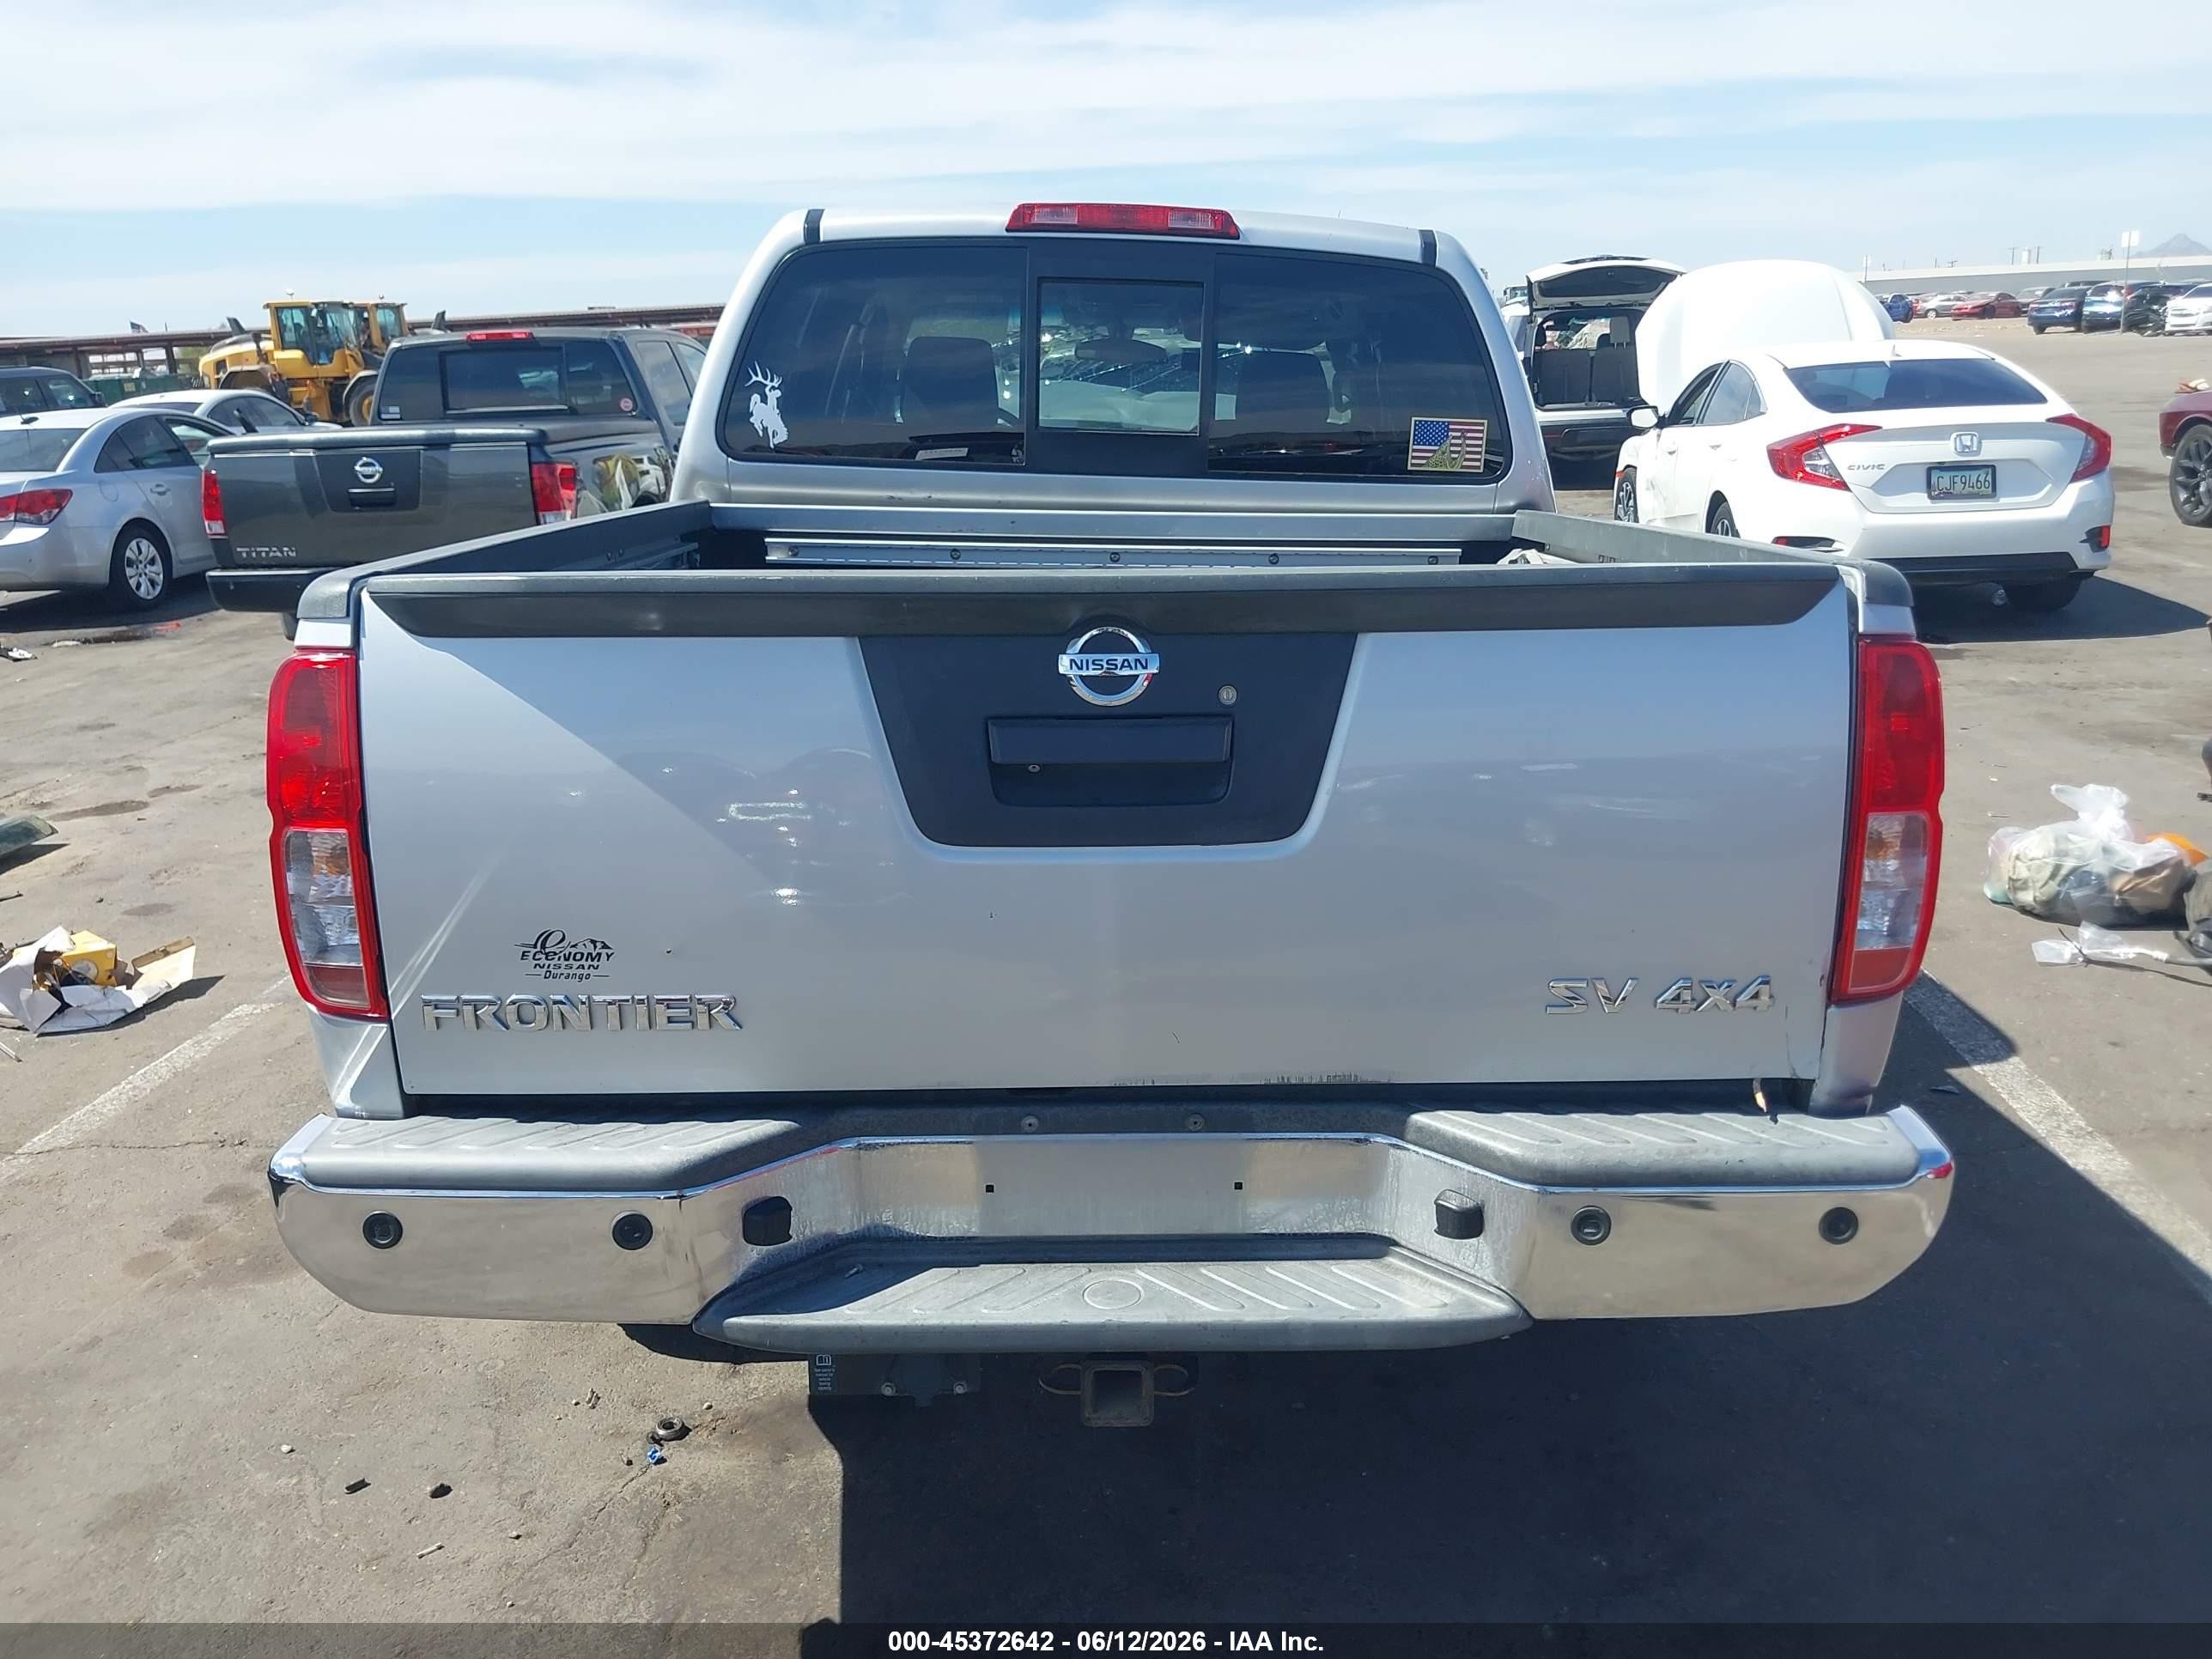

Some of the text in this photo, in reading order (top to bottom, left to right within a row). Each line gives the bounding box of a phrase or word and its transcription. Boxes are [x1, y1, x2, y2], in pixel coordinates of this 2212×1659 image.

[1936, 473, 1990, 491] CJF9466
[236, 547, 296, 558] TITAN
[1069, 658, 1149, 671] NISSAN
[520, 950, 615, 963] ECONOMY
[544, 969, 592, 983] Durango
[1546, 978, 1638, 1014] SV
[420, 994, 743, 1032] FRONTIER
